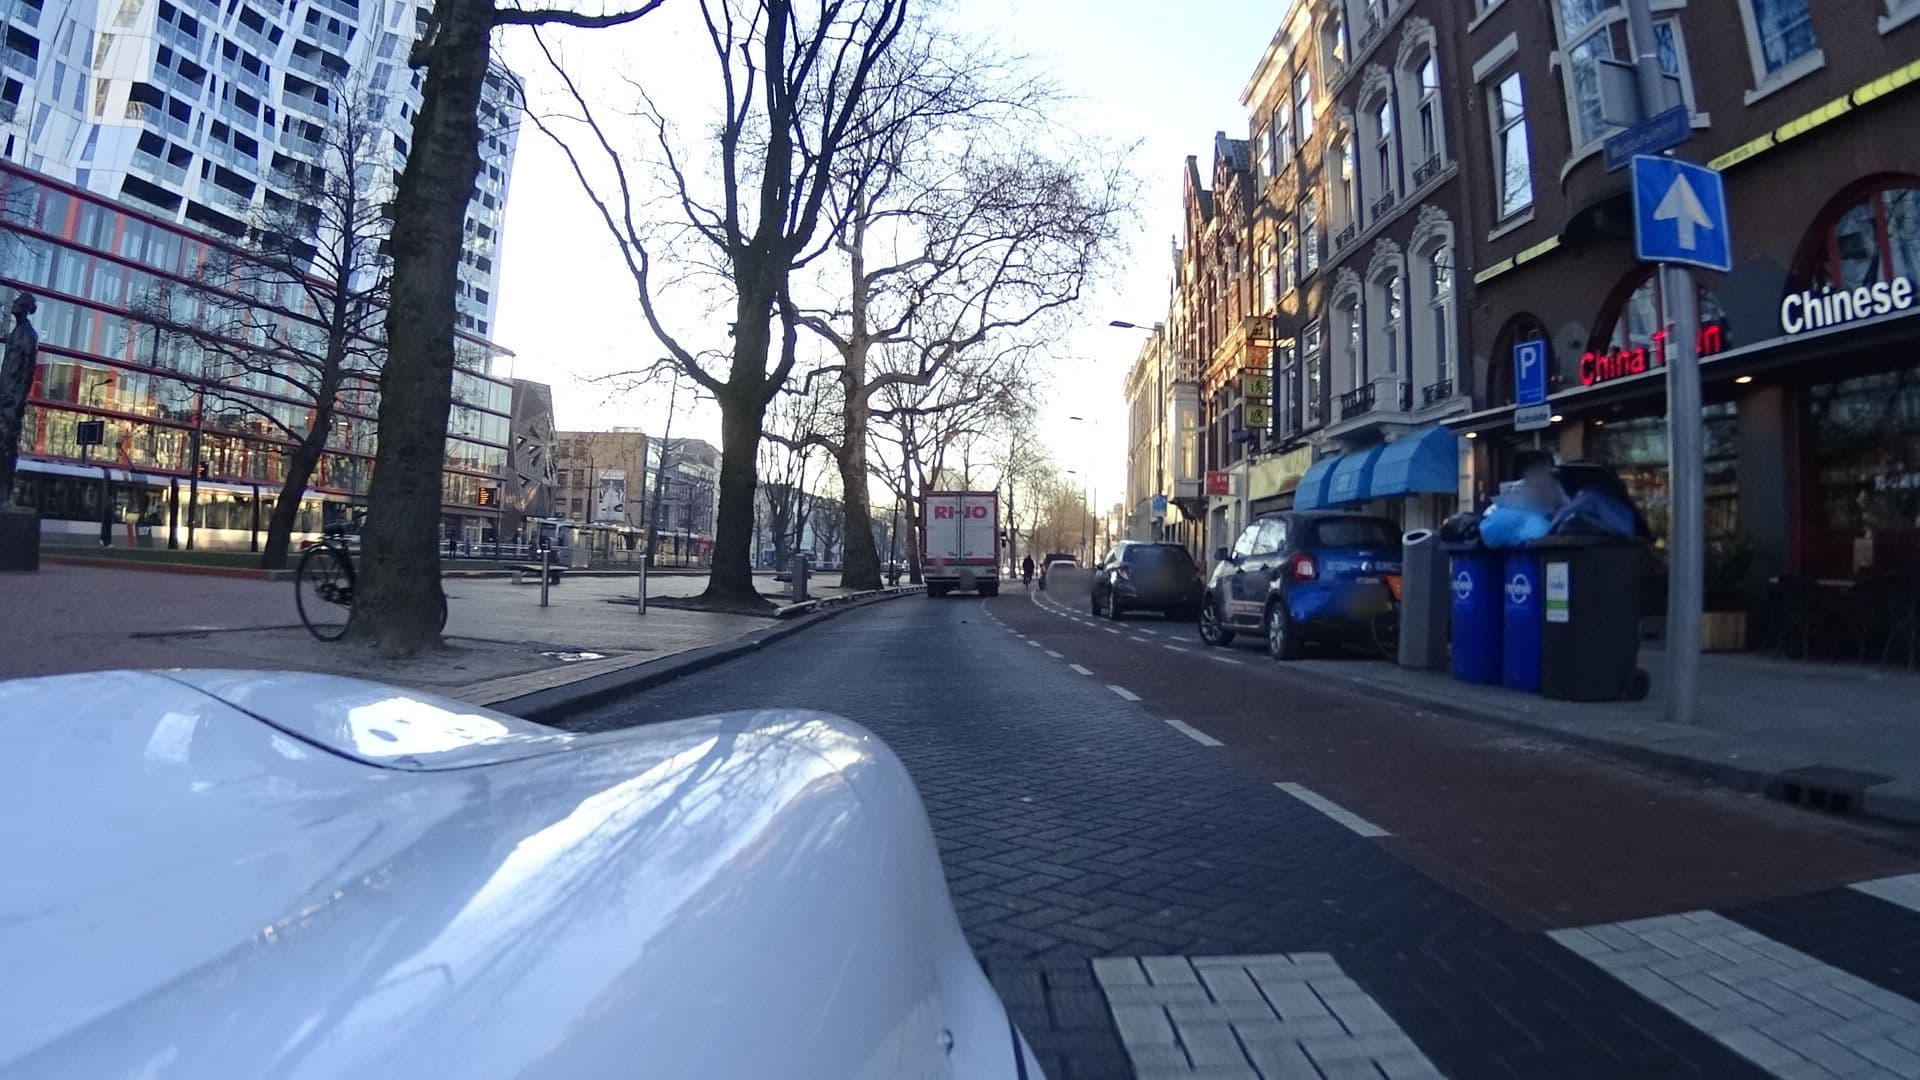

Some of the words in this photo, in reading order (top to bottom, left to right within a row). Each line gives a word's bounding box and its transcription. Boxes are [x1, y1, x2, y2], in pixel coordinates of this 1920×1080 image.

[1782, 276, 1912, 334] Chinese
[1521, 346, 1537, 380] P
[1580, 345, 1646, 386] China
[1651, 323, 1723, 366] Tn
